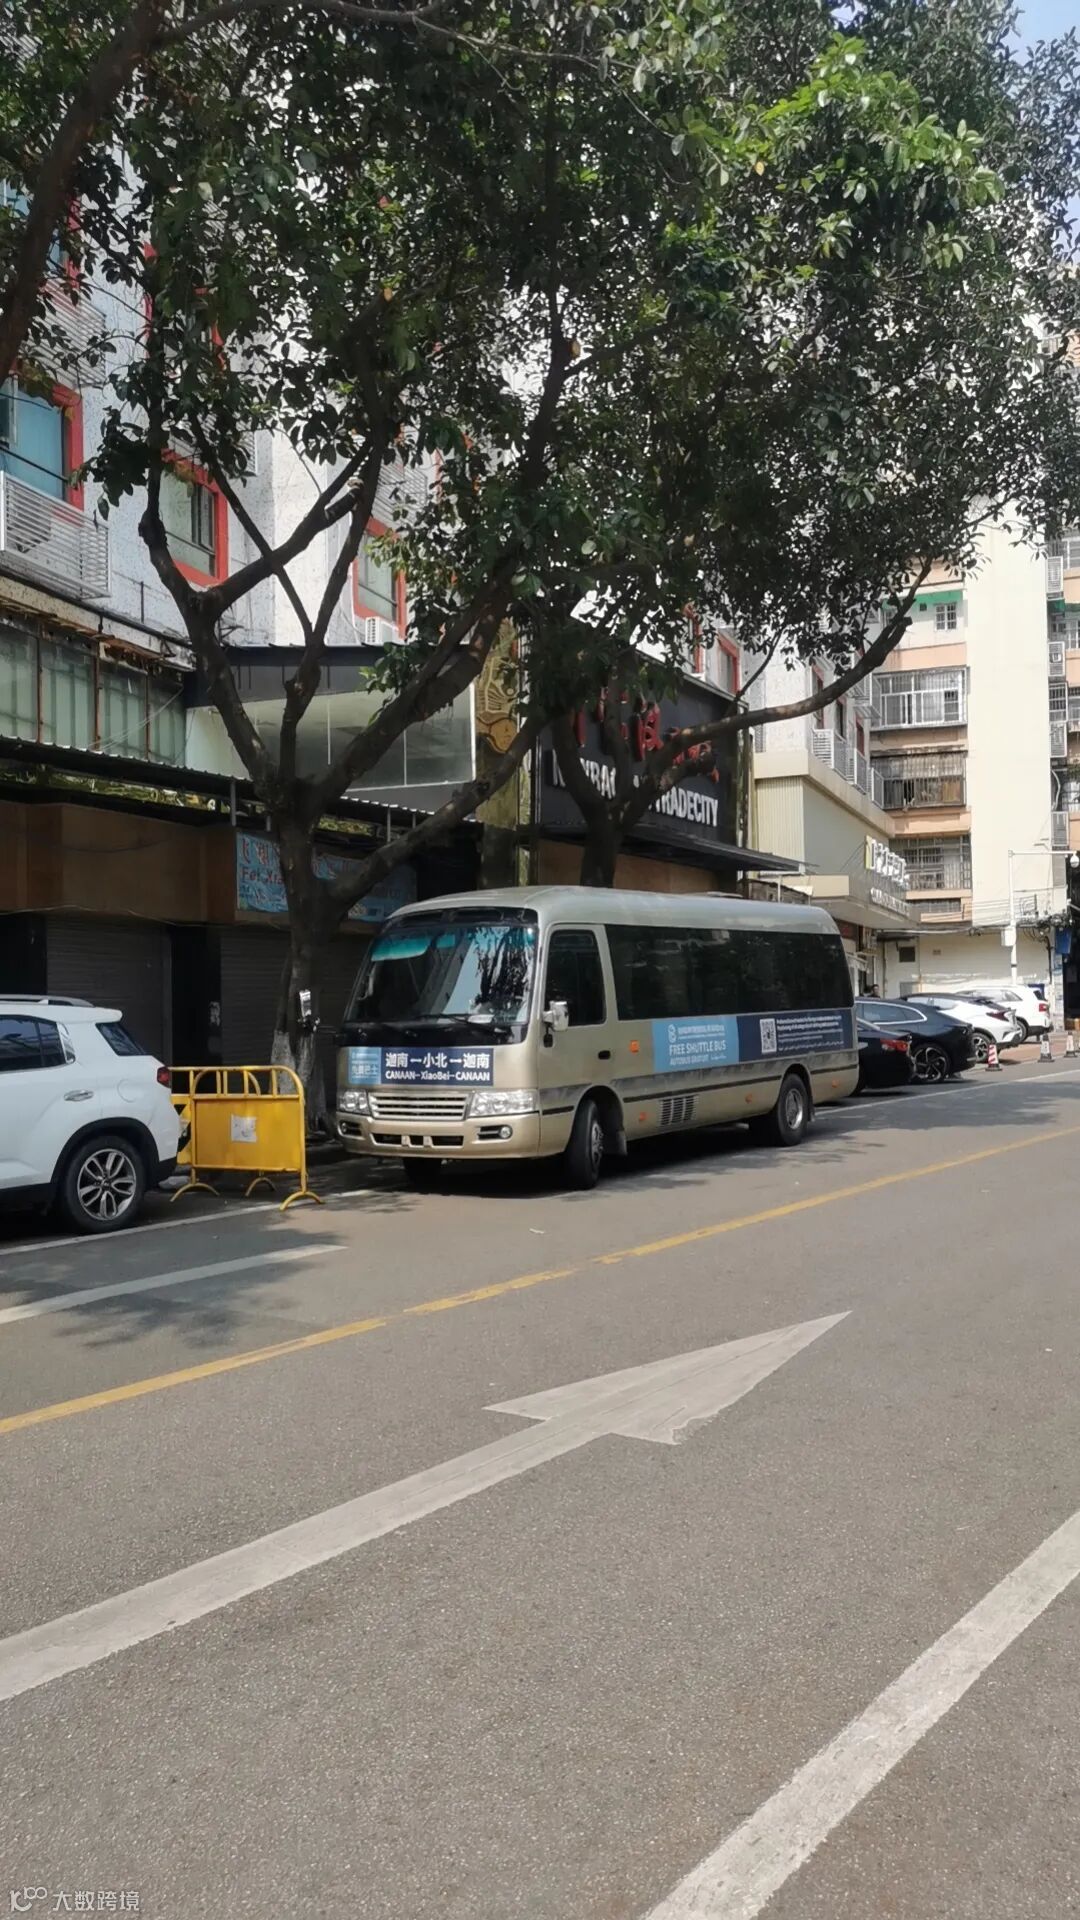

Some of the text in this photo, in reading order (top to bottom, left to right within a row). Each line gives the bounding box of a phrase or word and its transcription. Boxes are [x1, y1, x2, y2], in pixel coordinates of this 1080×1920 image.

[669, 1040, 727, 1056] FREE SHUTTLE BUS
